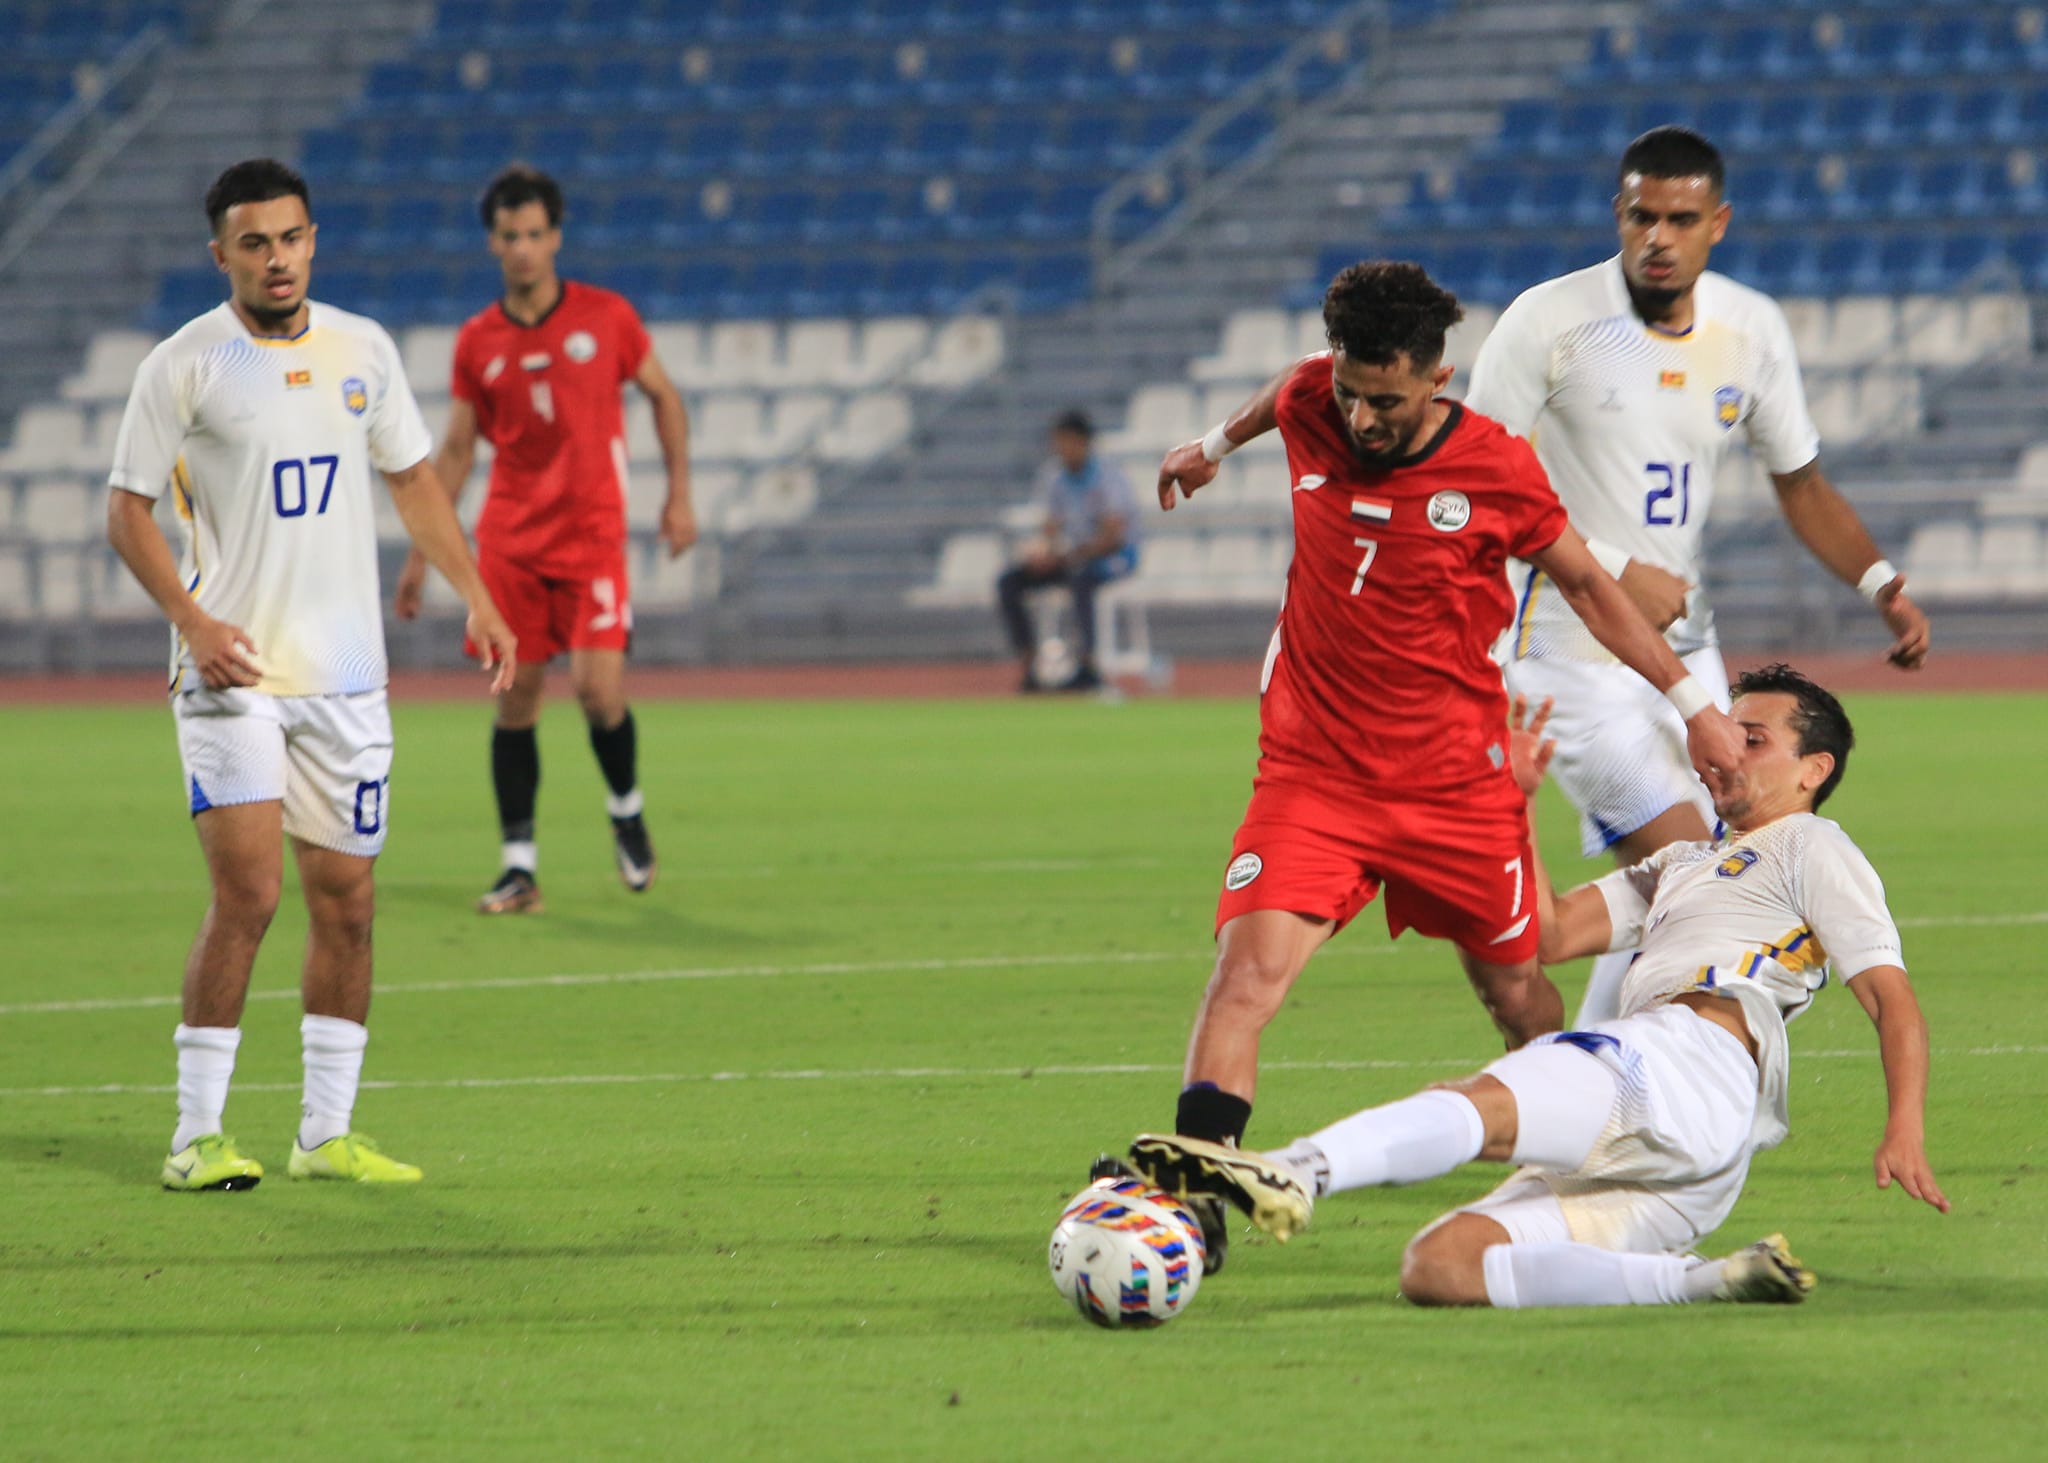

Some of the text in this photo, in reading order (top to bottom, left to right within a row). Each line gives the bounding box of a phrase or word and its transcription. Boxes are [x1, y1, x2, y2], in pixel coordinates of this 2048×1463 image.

[273, 455, 339, 518] 07
[1645, 462, 1691, 526] 21
[1350, 536, 1378, 596] 7
[354, 775, 388, 834] 0
[1504, 857, 1523, 918] 7
